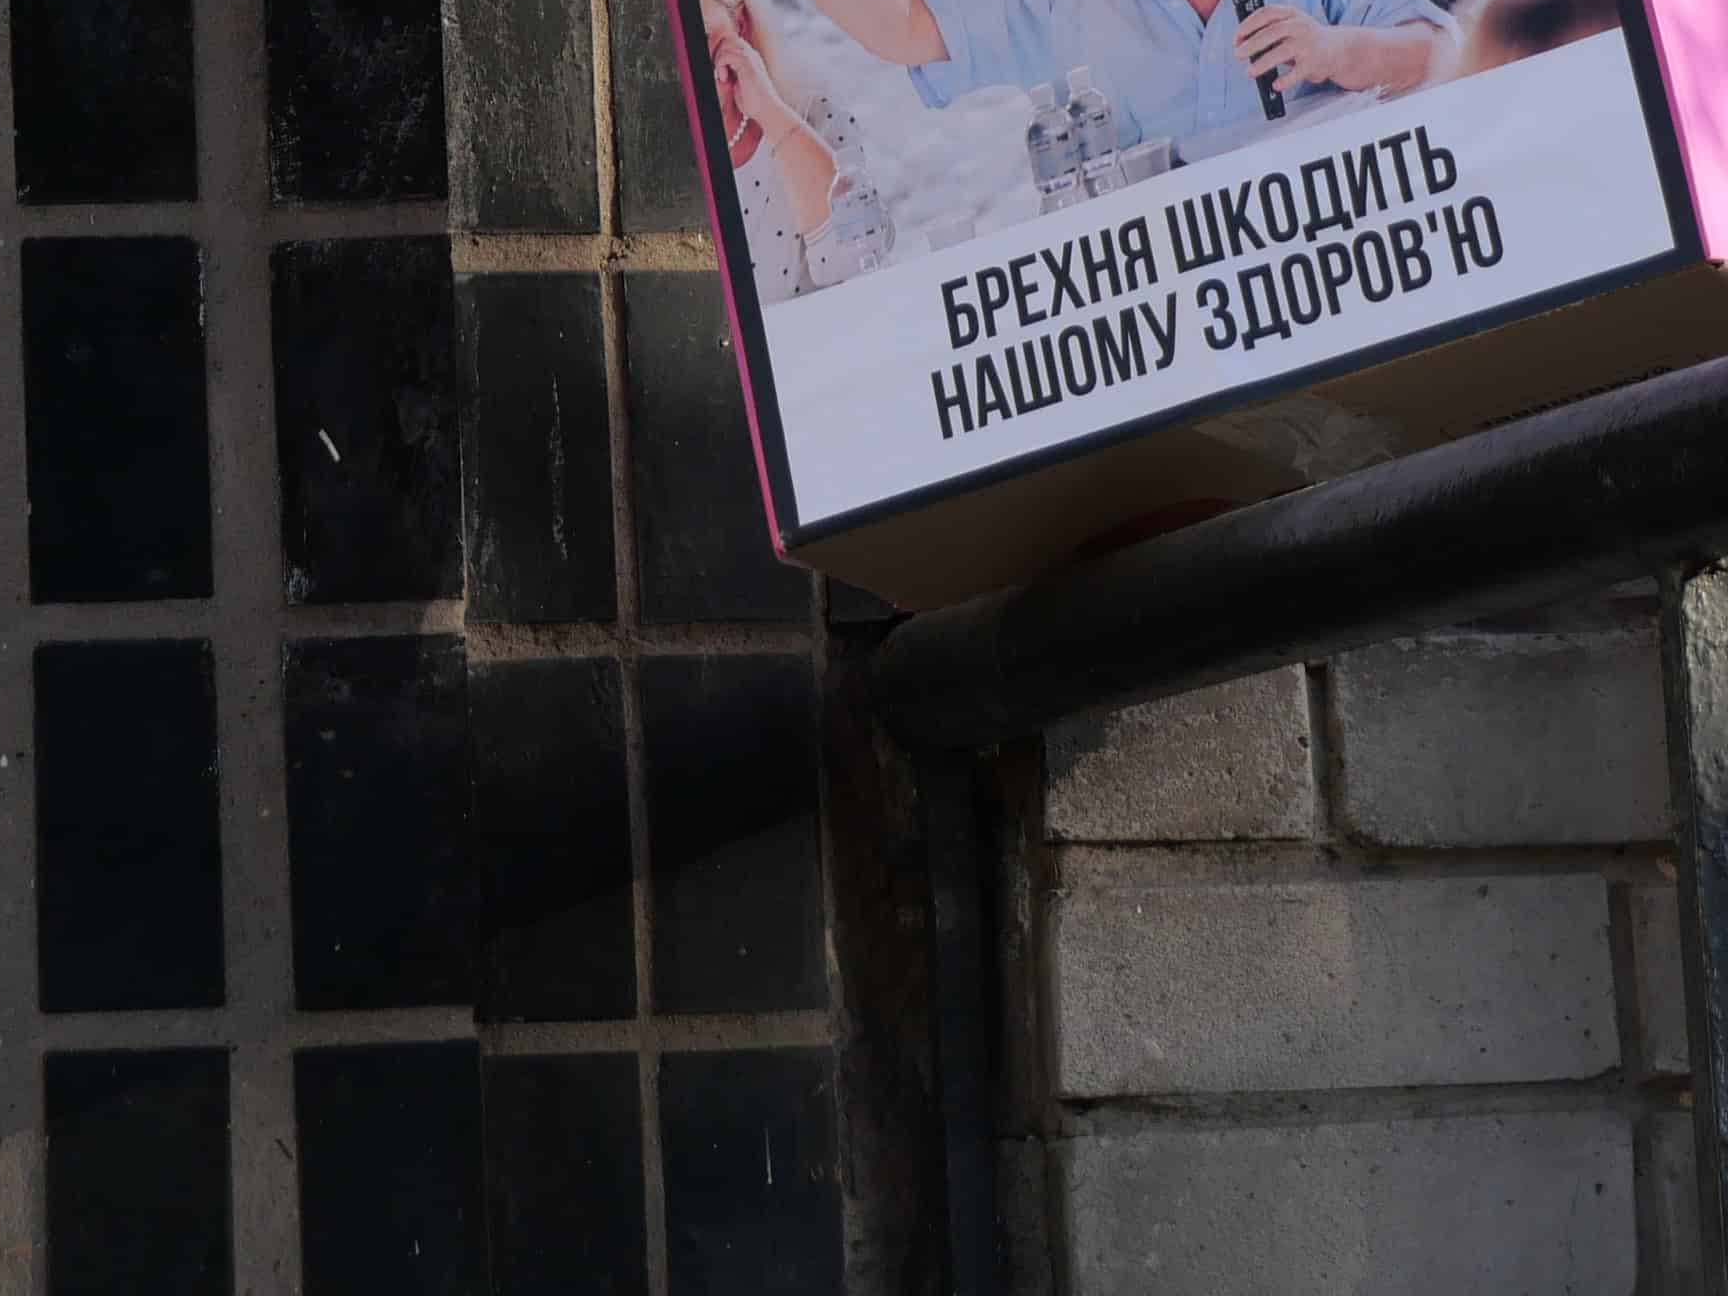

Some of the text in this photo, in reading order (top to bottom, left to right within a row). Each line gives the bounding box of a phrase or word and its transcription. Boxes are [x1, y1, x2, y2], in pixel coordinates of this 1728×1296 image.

[929, 196, 1504, 439] НАШОМУ ЗДОРОВ'Ю
[940, 125, 1458, 351] БРЕХНЯ ШКОДИТЬ
